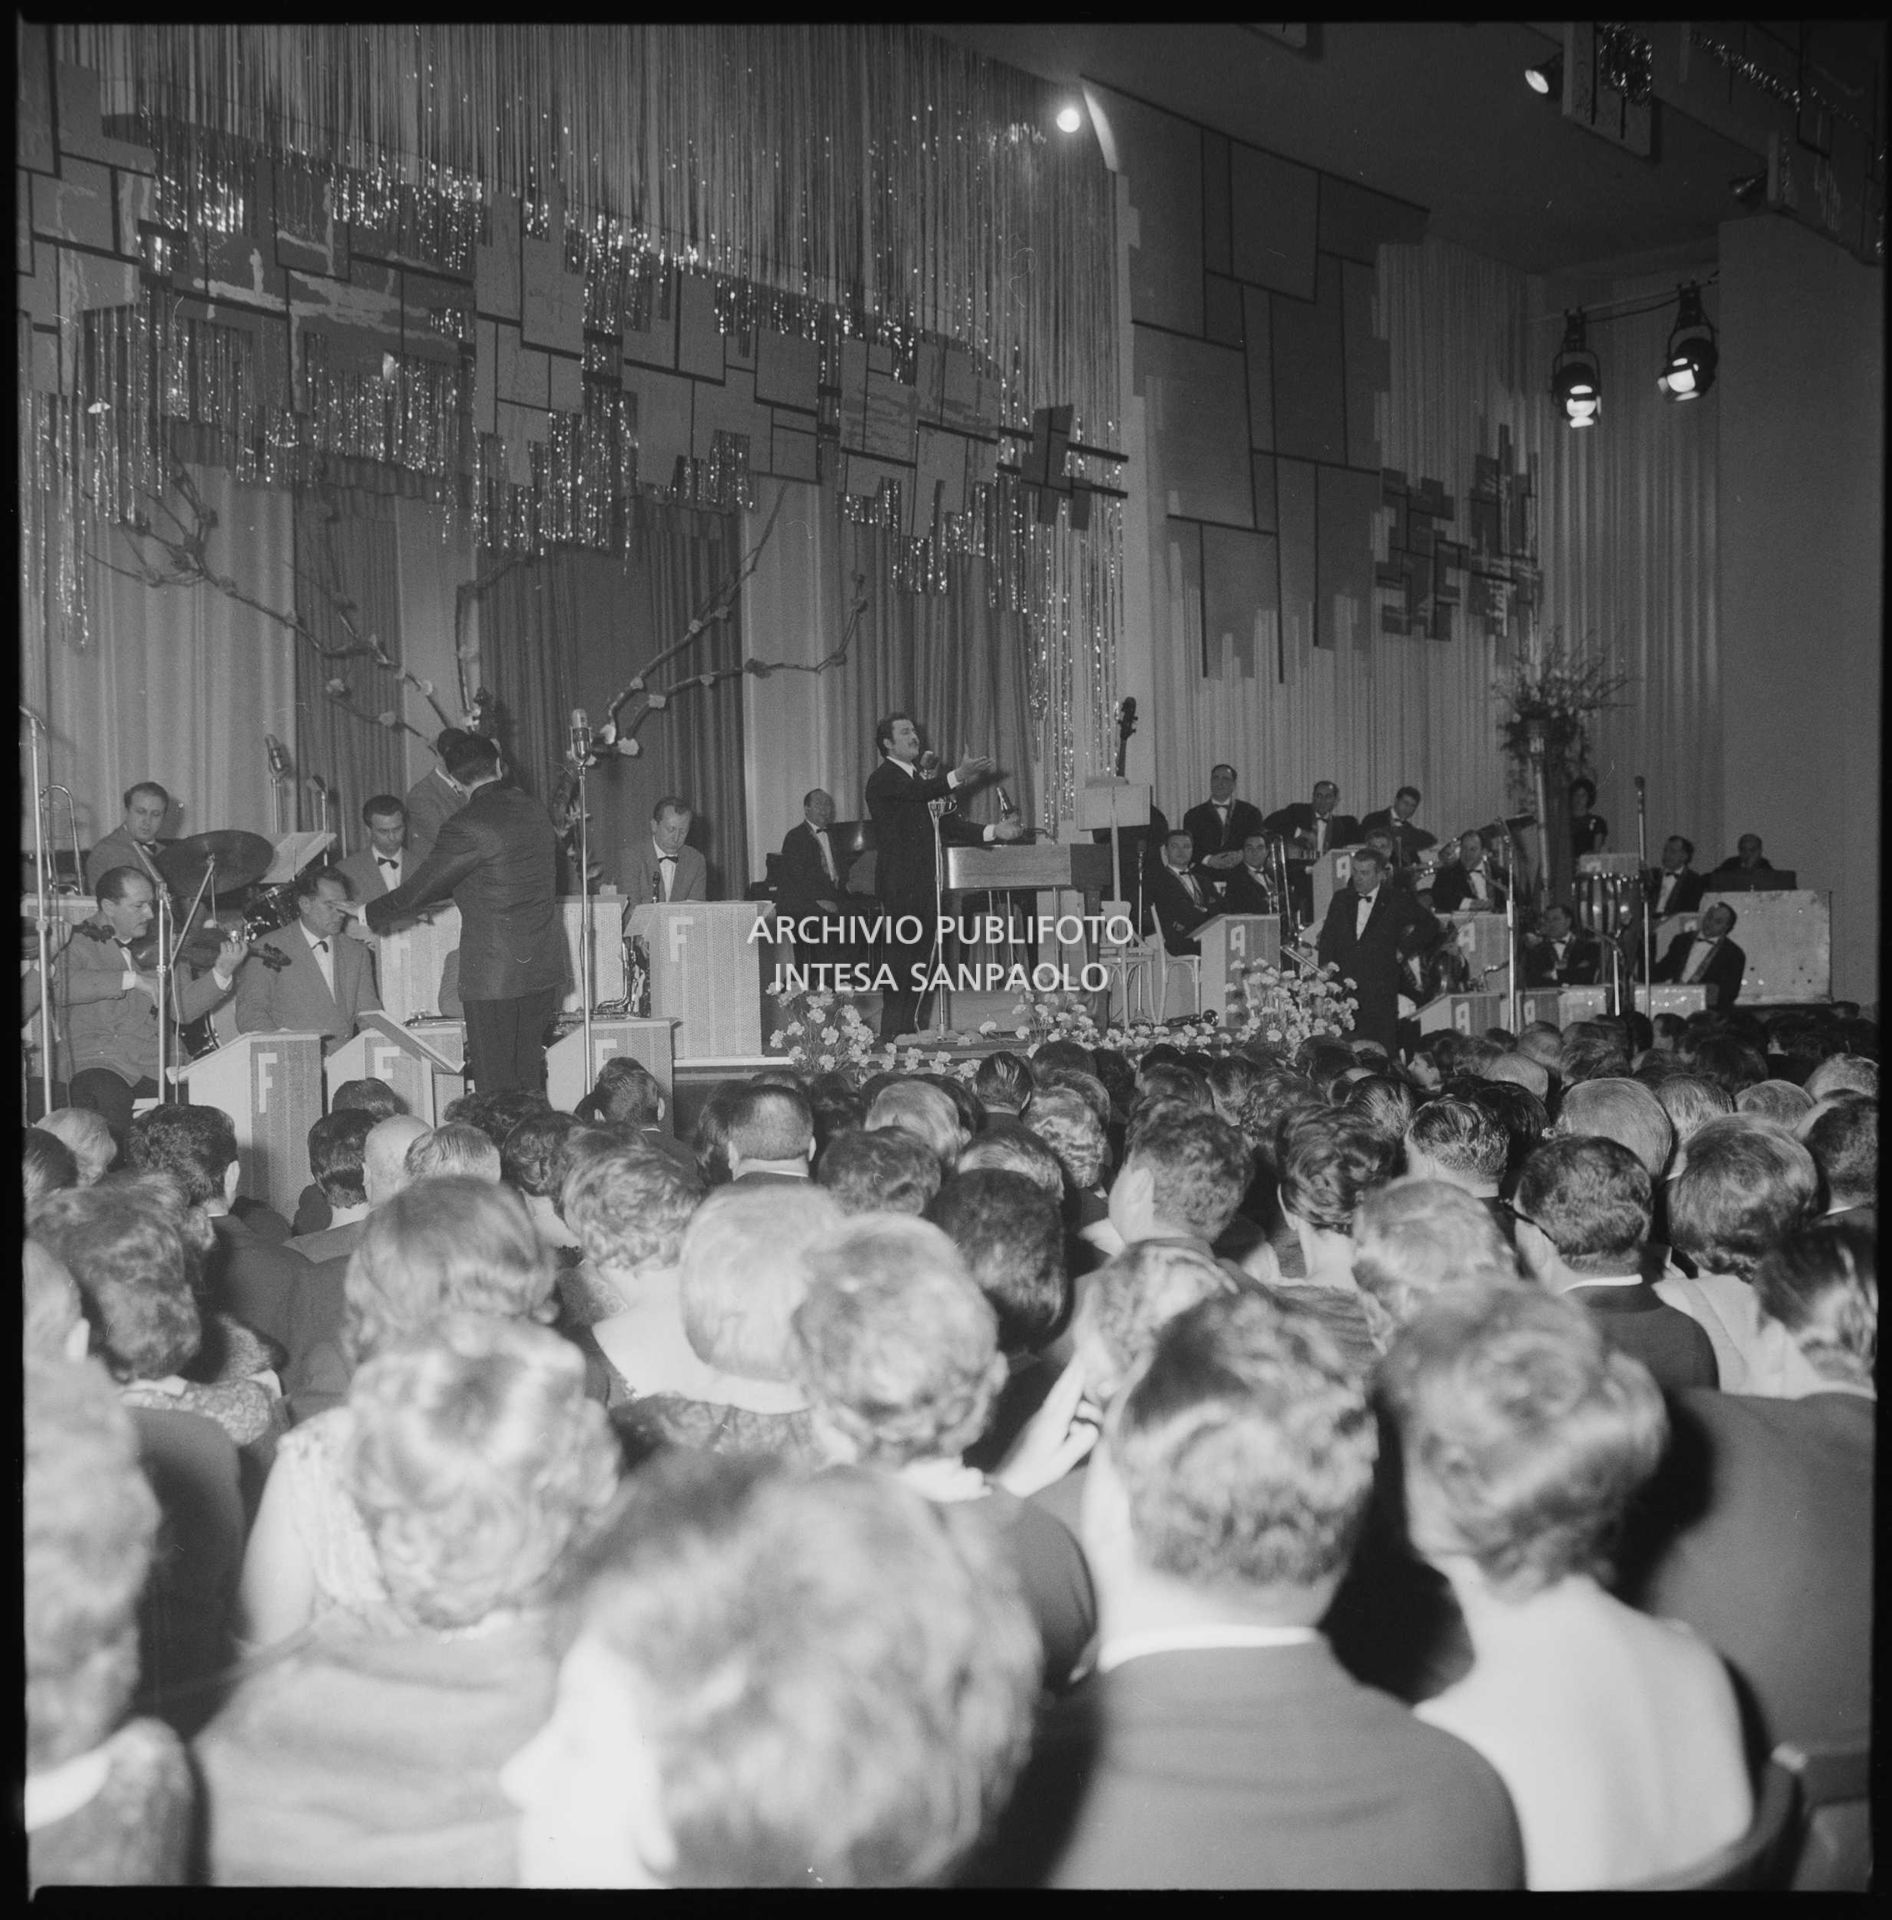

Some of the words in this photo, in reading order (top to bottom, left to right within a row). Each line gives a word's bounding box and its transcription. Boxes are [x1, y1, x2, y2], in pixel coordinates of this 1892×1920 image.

[668, 916, 693, 962] F
[1230, 924, 1245, 957] A
[1457, 921, 1475, 952] A
[1455, 1001, 1471, 1036] A
[258, 1052, 278, 1113] F
